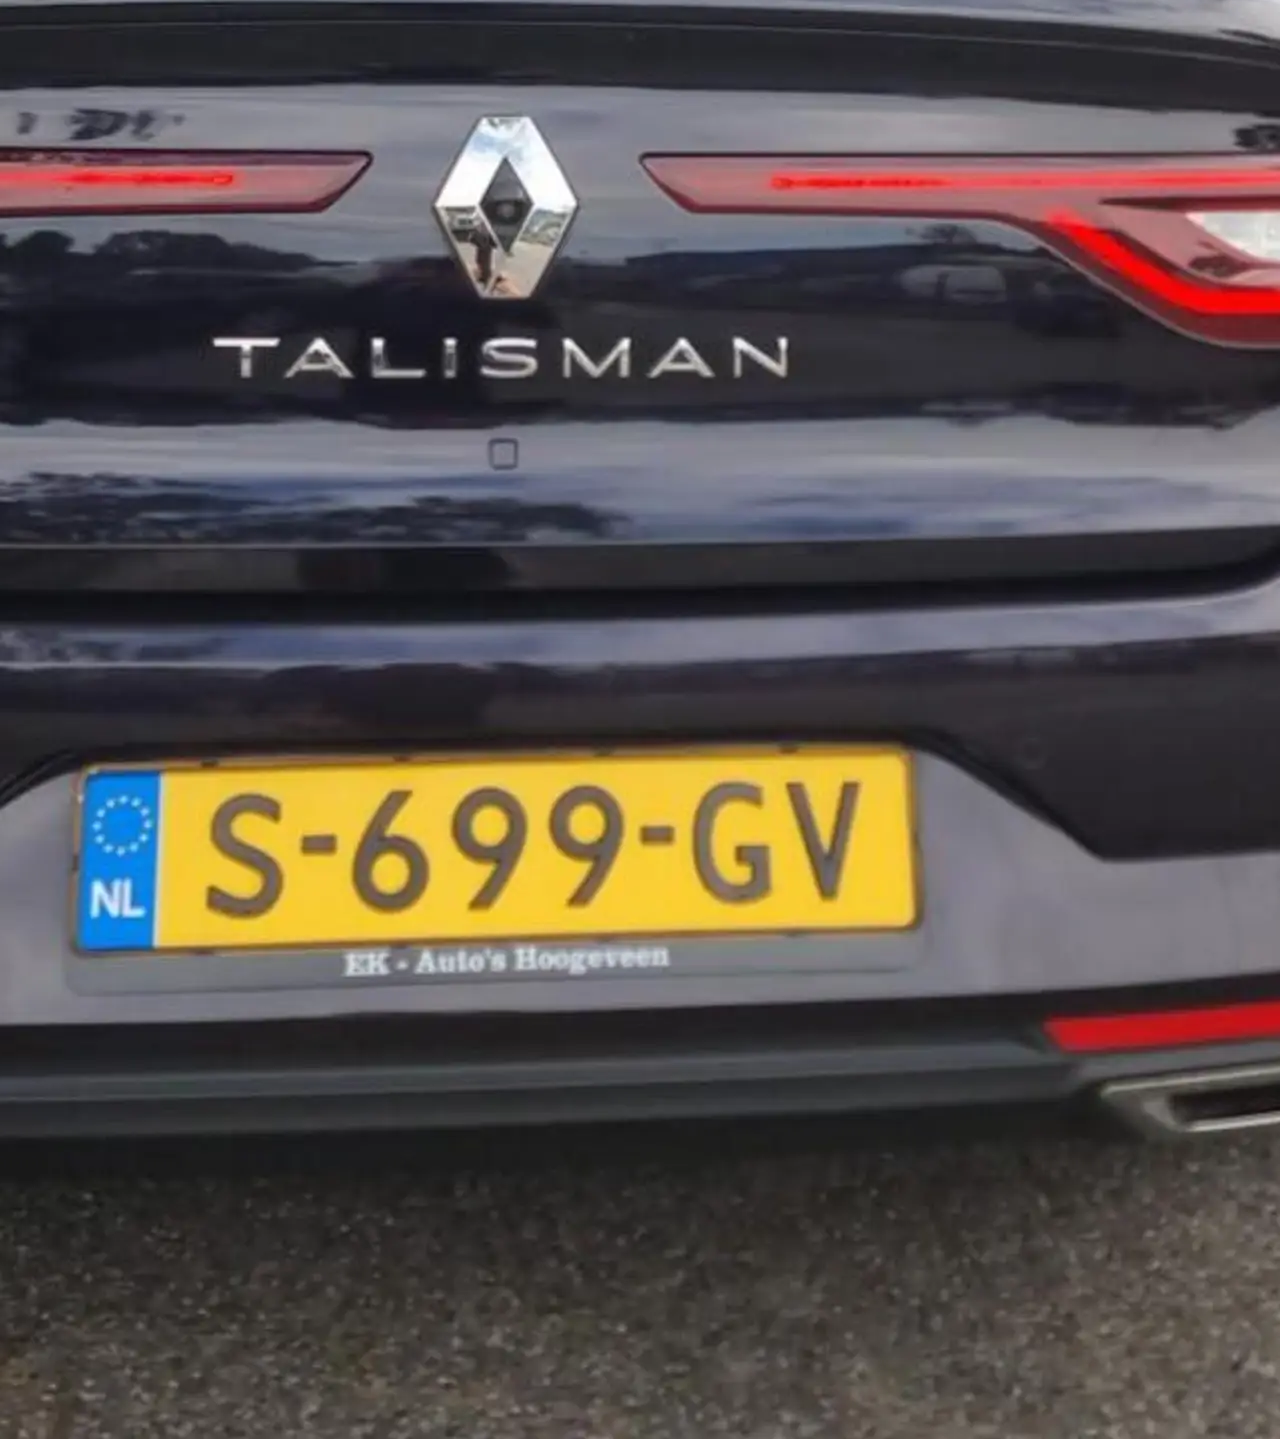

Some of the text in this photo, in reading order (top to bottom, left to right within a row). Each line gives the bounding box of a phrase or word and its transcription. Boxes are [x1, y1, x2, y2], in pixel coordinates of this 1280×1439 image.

[213, 337, 789, 378] TALISMAN
[205, 781, 861, 919] S-699-GV
[89, 879, 146, 918] NL
[343, 948, 391, 977] EK
[414, 947, 508, 975] Auto's
[513, 945, 670, 975] Hoogeveen
